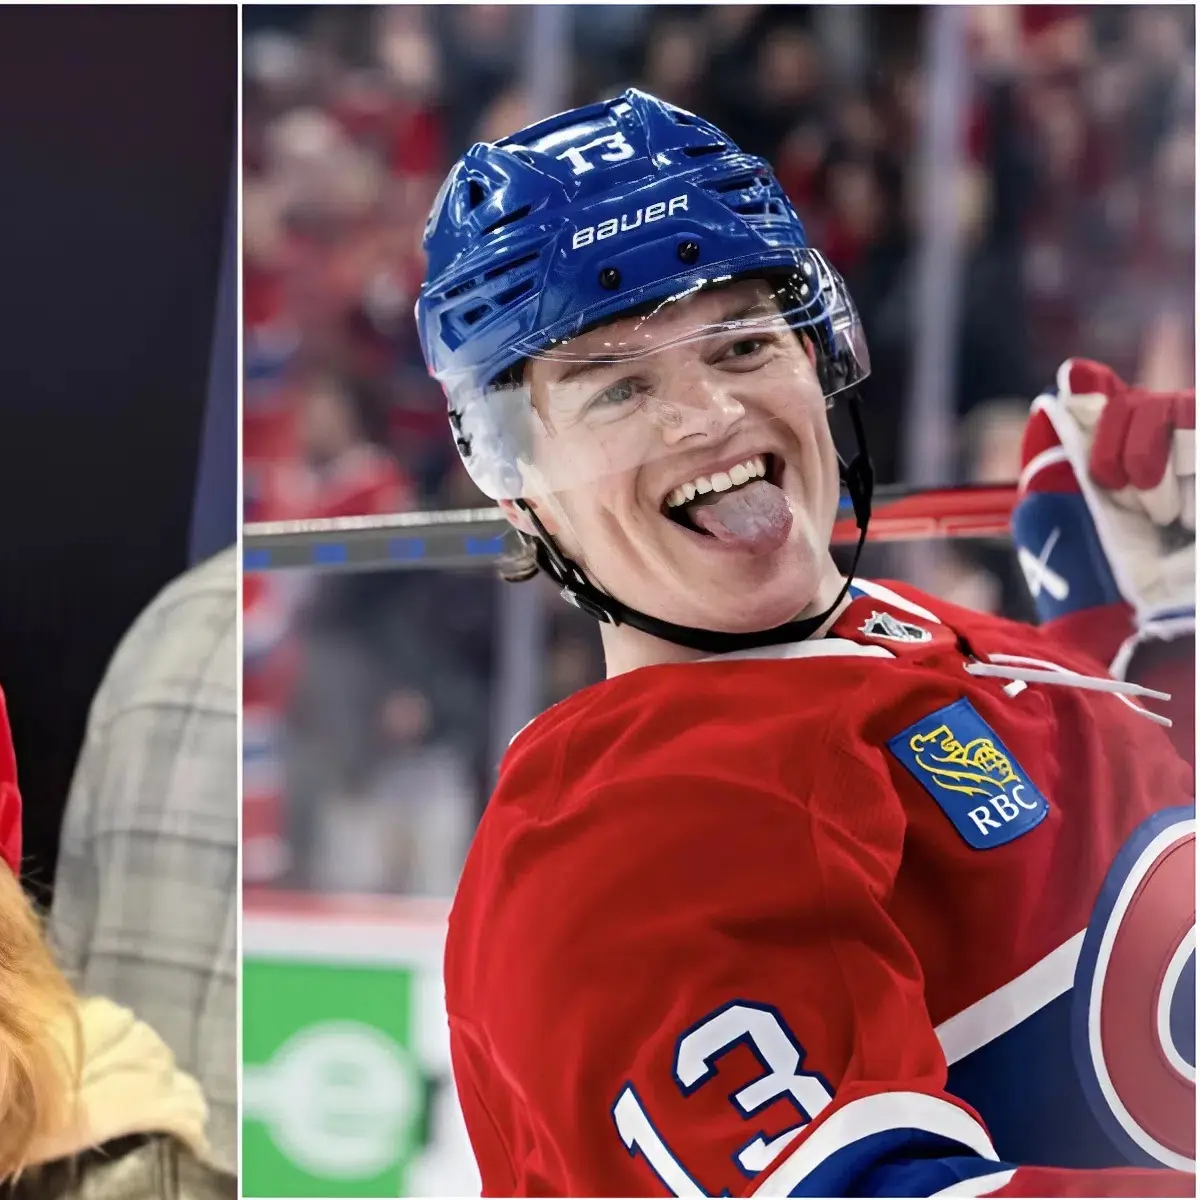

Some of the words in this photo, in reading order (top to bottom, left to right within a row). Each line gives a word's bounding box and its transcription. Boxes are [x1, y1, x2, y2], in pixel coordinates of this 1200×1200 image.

[556, 131, 635, 176] 13
[572, 194, 689, 249] BAUER
[967, 784, 1038, 836] RBC
